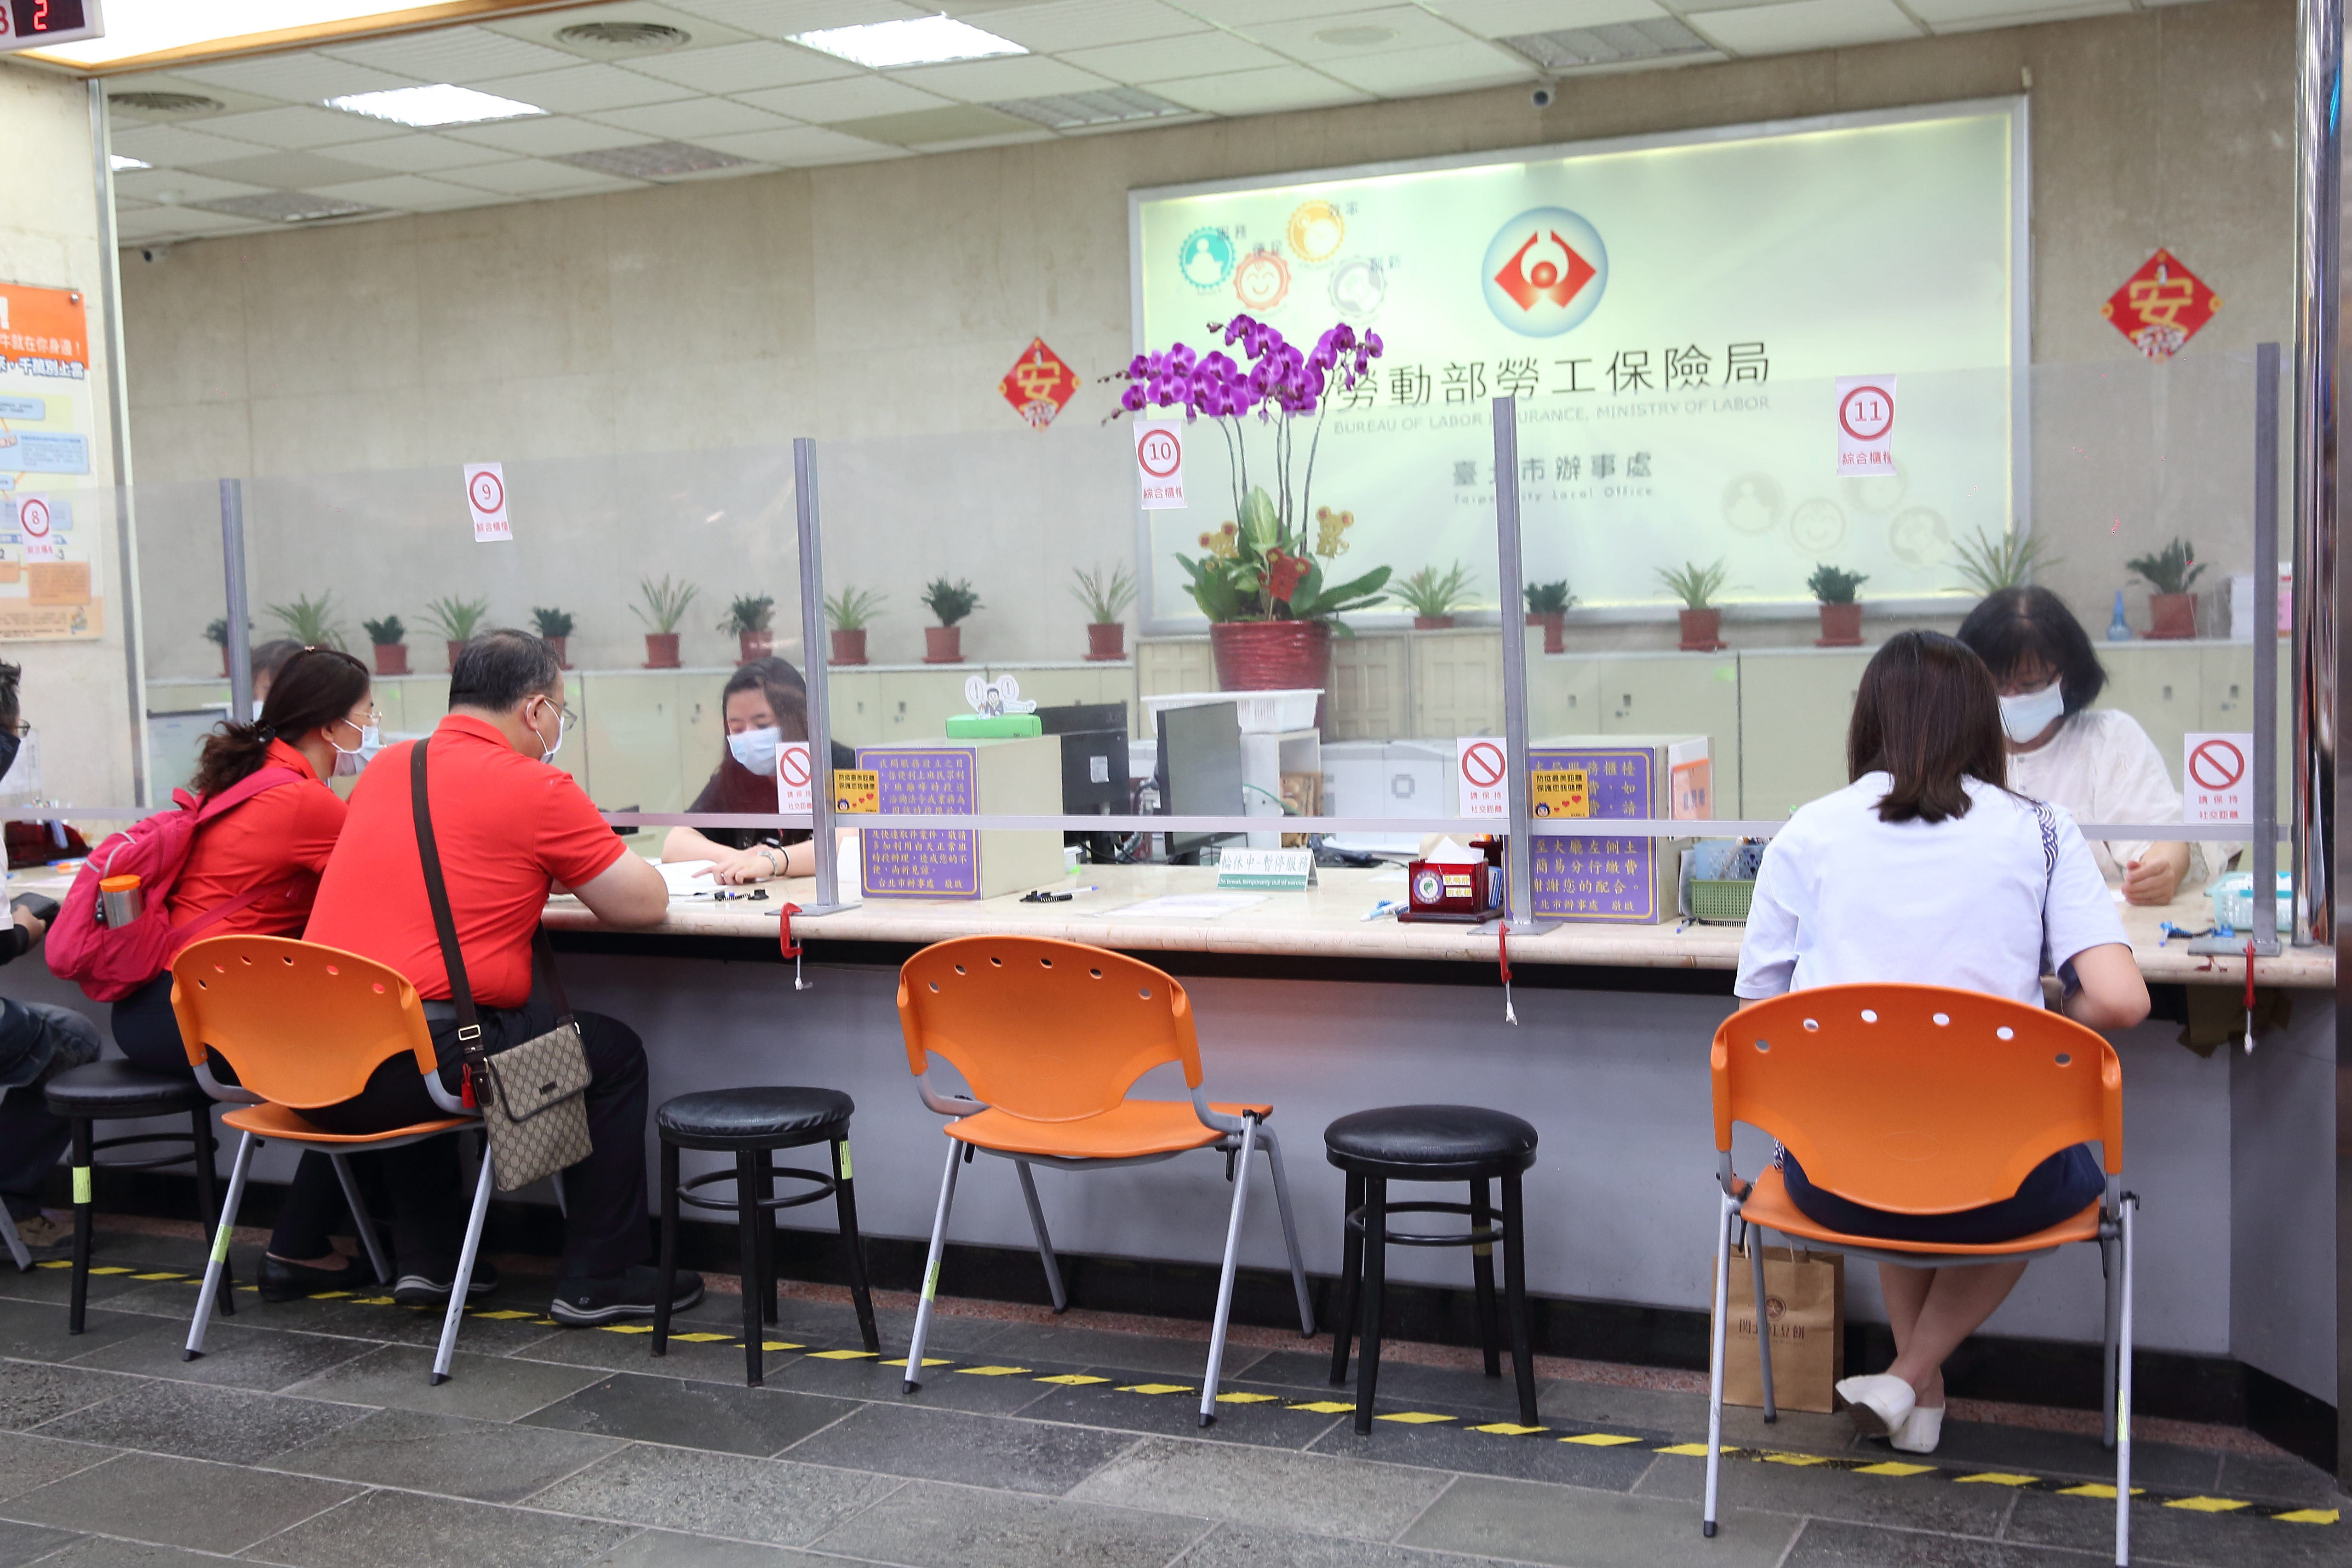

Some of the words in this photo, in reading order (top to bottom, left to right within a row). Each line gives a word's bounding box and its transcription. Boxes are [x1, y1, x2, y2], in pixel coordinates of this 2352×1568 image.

[1336, 342, 1769, 413] 勞動部勞工保險局
[1333, 418, 1396, 435] BUREAU
[1430, 413, 1482, 429] LABOR
[1597, 401, 1678, 419] MINISTRY
[1713, 396, 1769, 412] LABOR
[1854, 401, 1882, 422] 11
[1149, 441, 1172, 462] 10
[1454, 452, 1654, 486] 臺市辦事處
[482, 484, 491, 499] 9
[32, 510, 40, 524] 8
[1535, 899, 1598, 912] 北市辦事處
